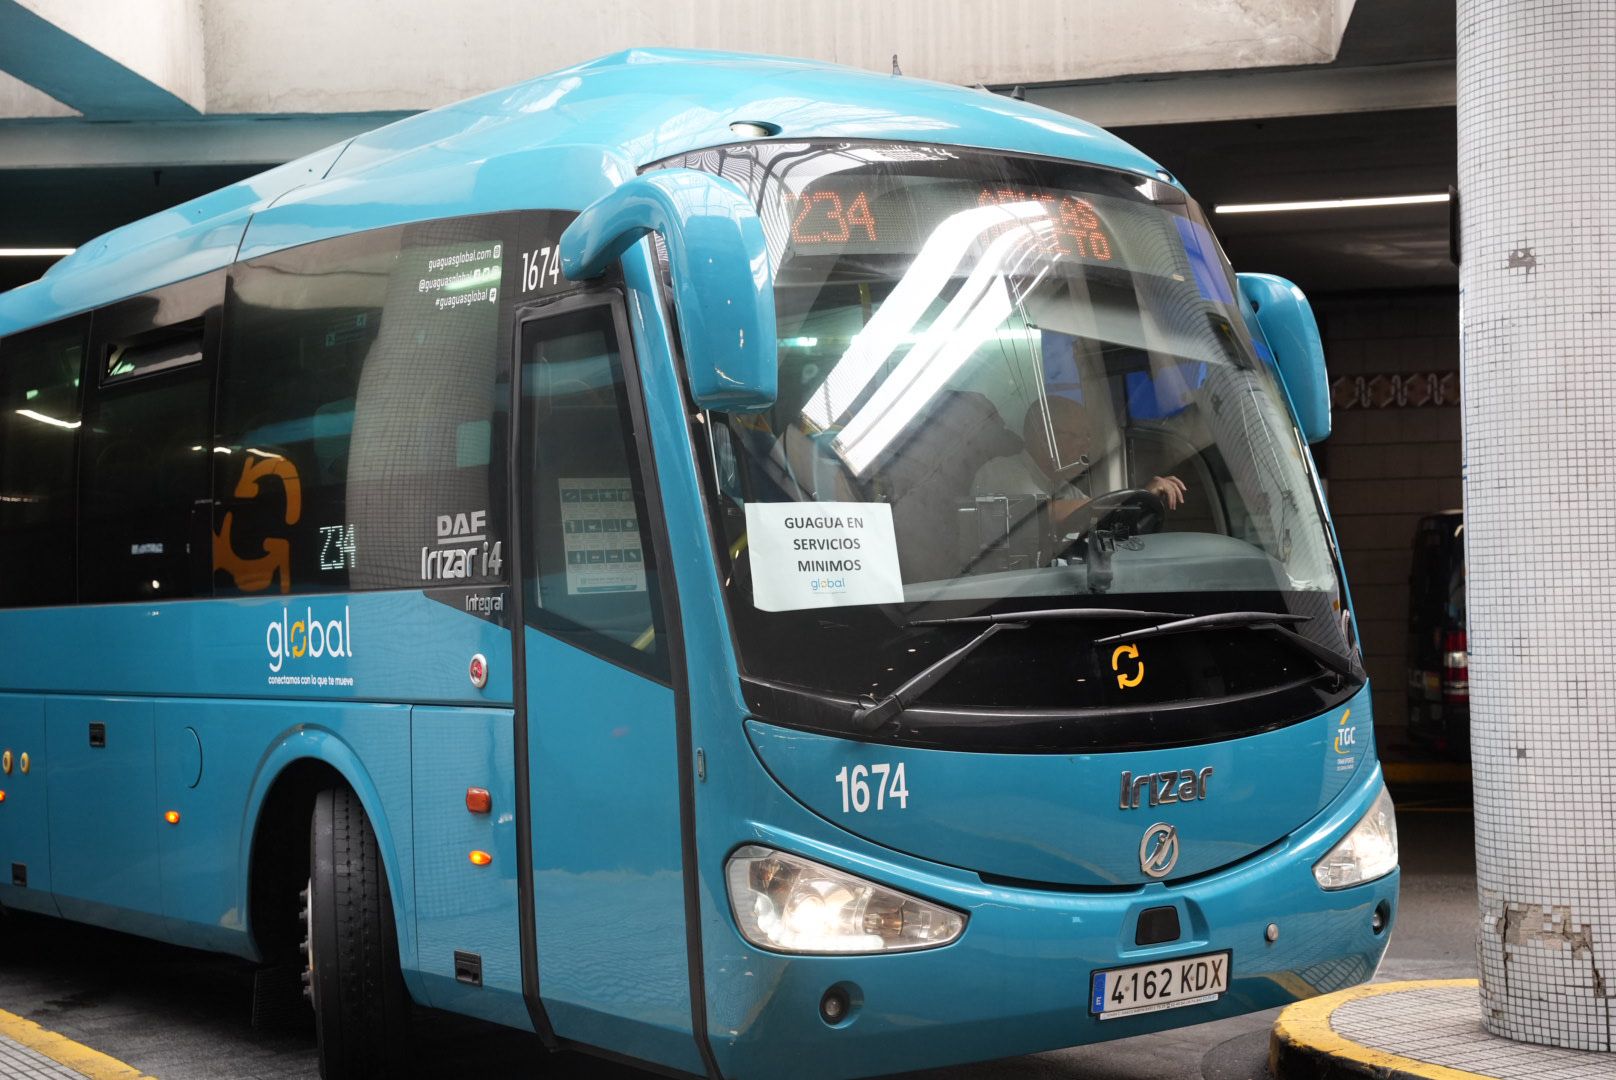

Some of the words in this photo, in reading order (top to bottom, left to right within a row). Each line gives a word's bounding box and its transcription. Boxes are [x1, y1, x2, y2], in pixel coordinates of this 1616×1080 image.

[428, 249, 491, 272] guaguasglobal.com
[522, 244, 560, 293] 1674
[435, 288, 488, 310] #guaguasglobal
[437, 510, 486, 537] DAF
[784, 517, 843, 529] GUAGUA
[848, 517, 864, 529] EN
[320, 524, 356, 570] 234
[793, 538, 861, 550] SERVICIOS
[421, 546, 478, 580] Irizar
[482, 541, 503, 577] i4
[797, 560, 862, 572] MINIMOS
[810, 578, 846, 591] global
[465, 592, 504, 616] Integral
[266, 605, 353, 672] global
[268, 675, 301, 685] conectamos
[301, 676, 310, 685] con
[317, 676, 328, 687] que
[328, 675, 334, 686] te
[335, 677, 354, 686] mueve
[1337, 726, 1356, 746] TGC
[835, 762, 909, 813] 1674
[1119, 766, 1213, 809] Irizar
[1111, 967, 1173, 1005] 4162
[1180, 958, 1223, 994] KDX
